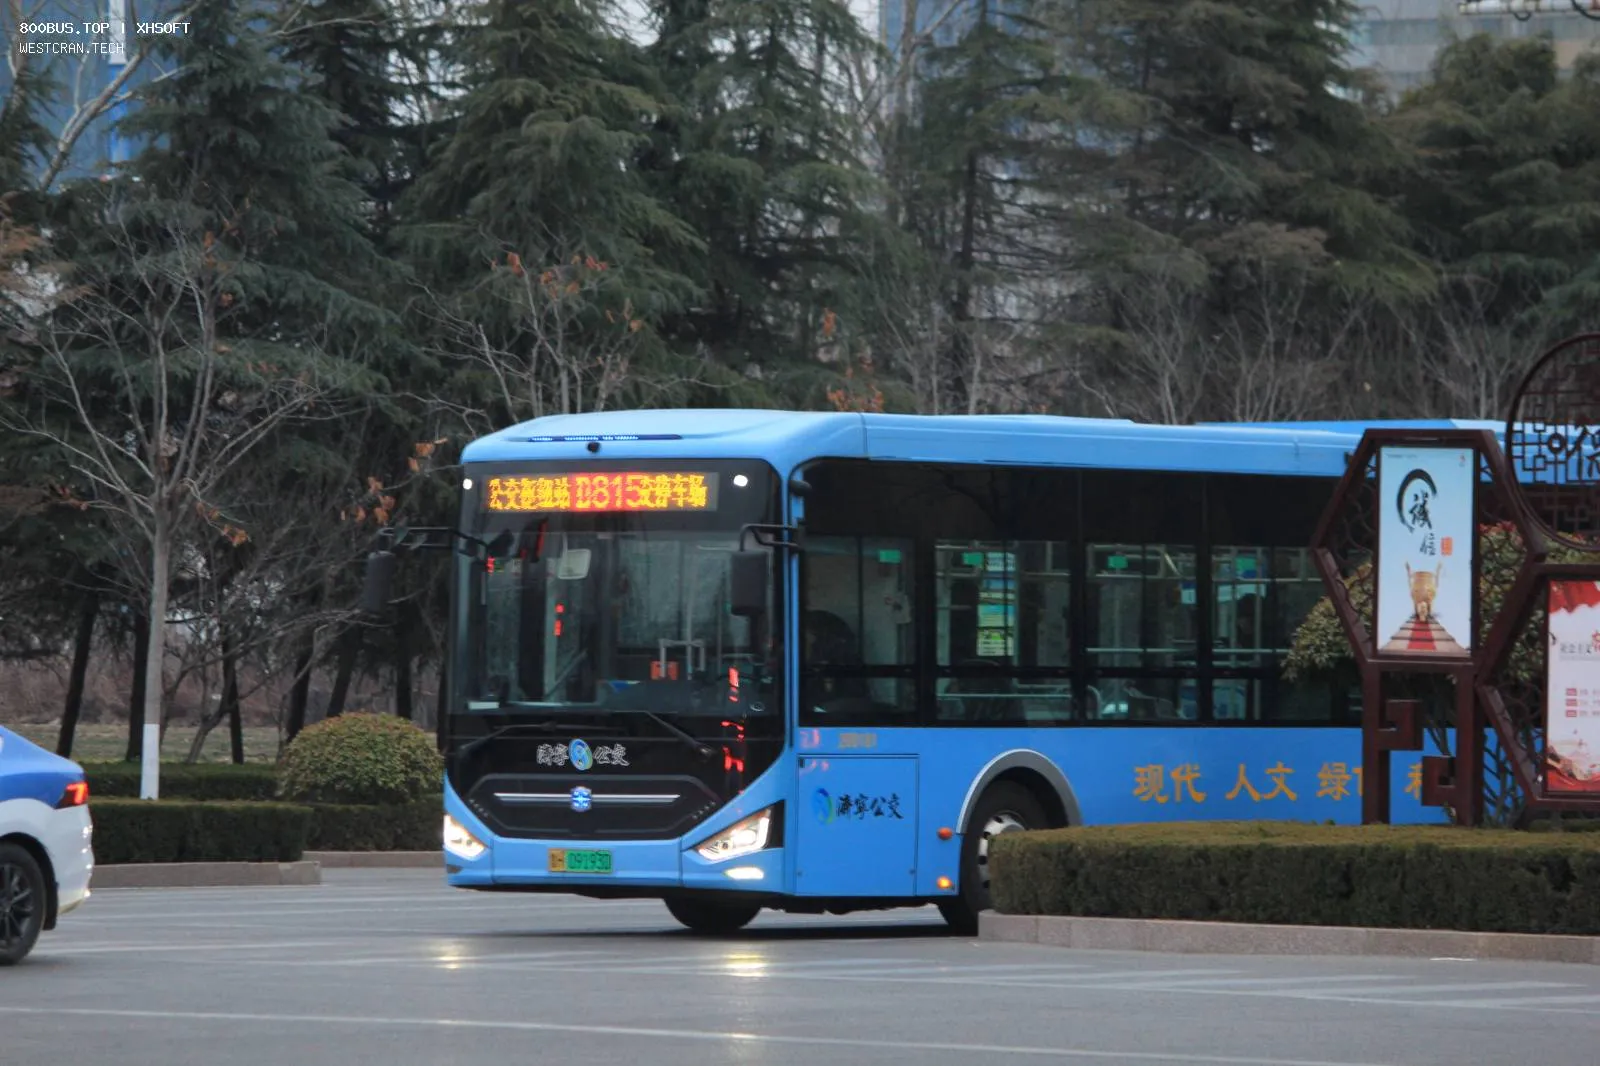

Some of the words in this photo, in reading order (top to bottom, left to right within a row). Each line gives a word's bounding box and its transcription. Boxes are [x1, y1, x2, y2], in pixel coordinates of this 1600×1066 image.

[1133, 763, 1206, 803] 现代
[1225, 761, 1298, 802] 人文
[1316, 761, 1363, 801] 绿
